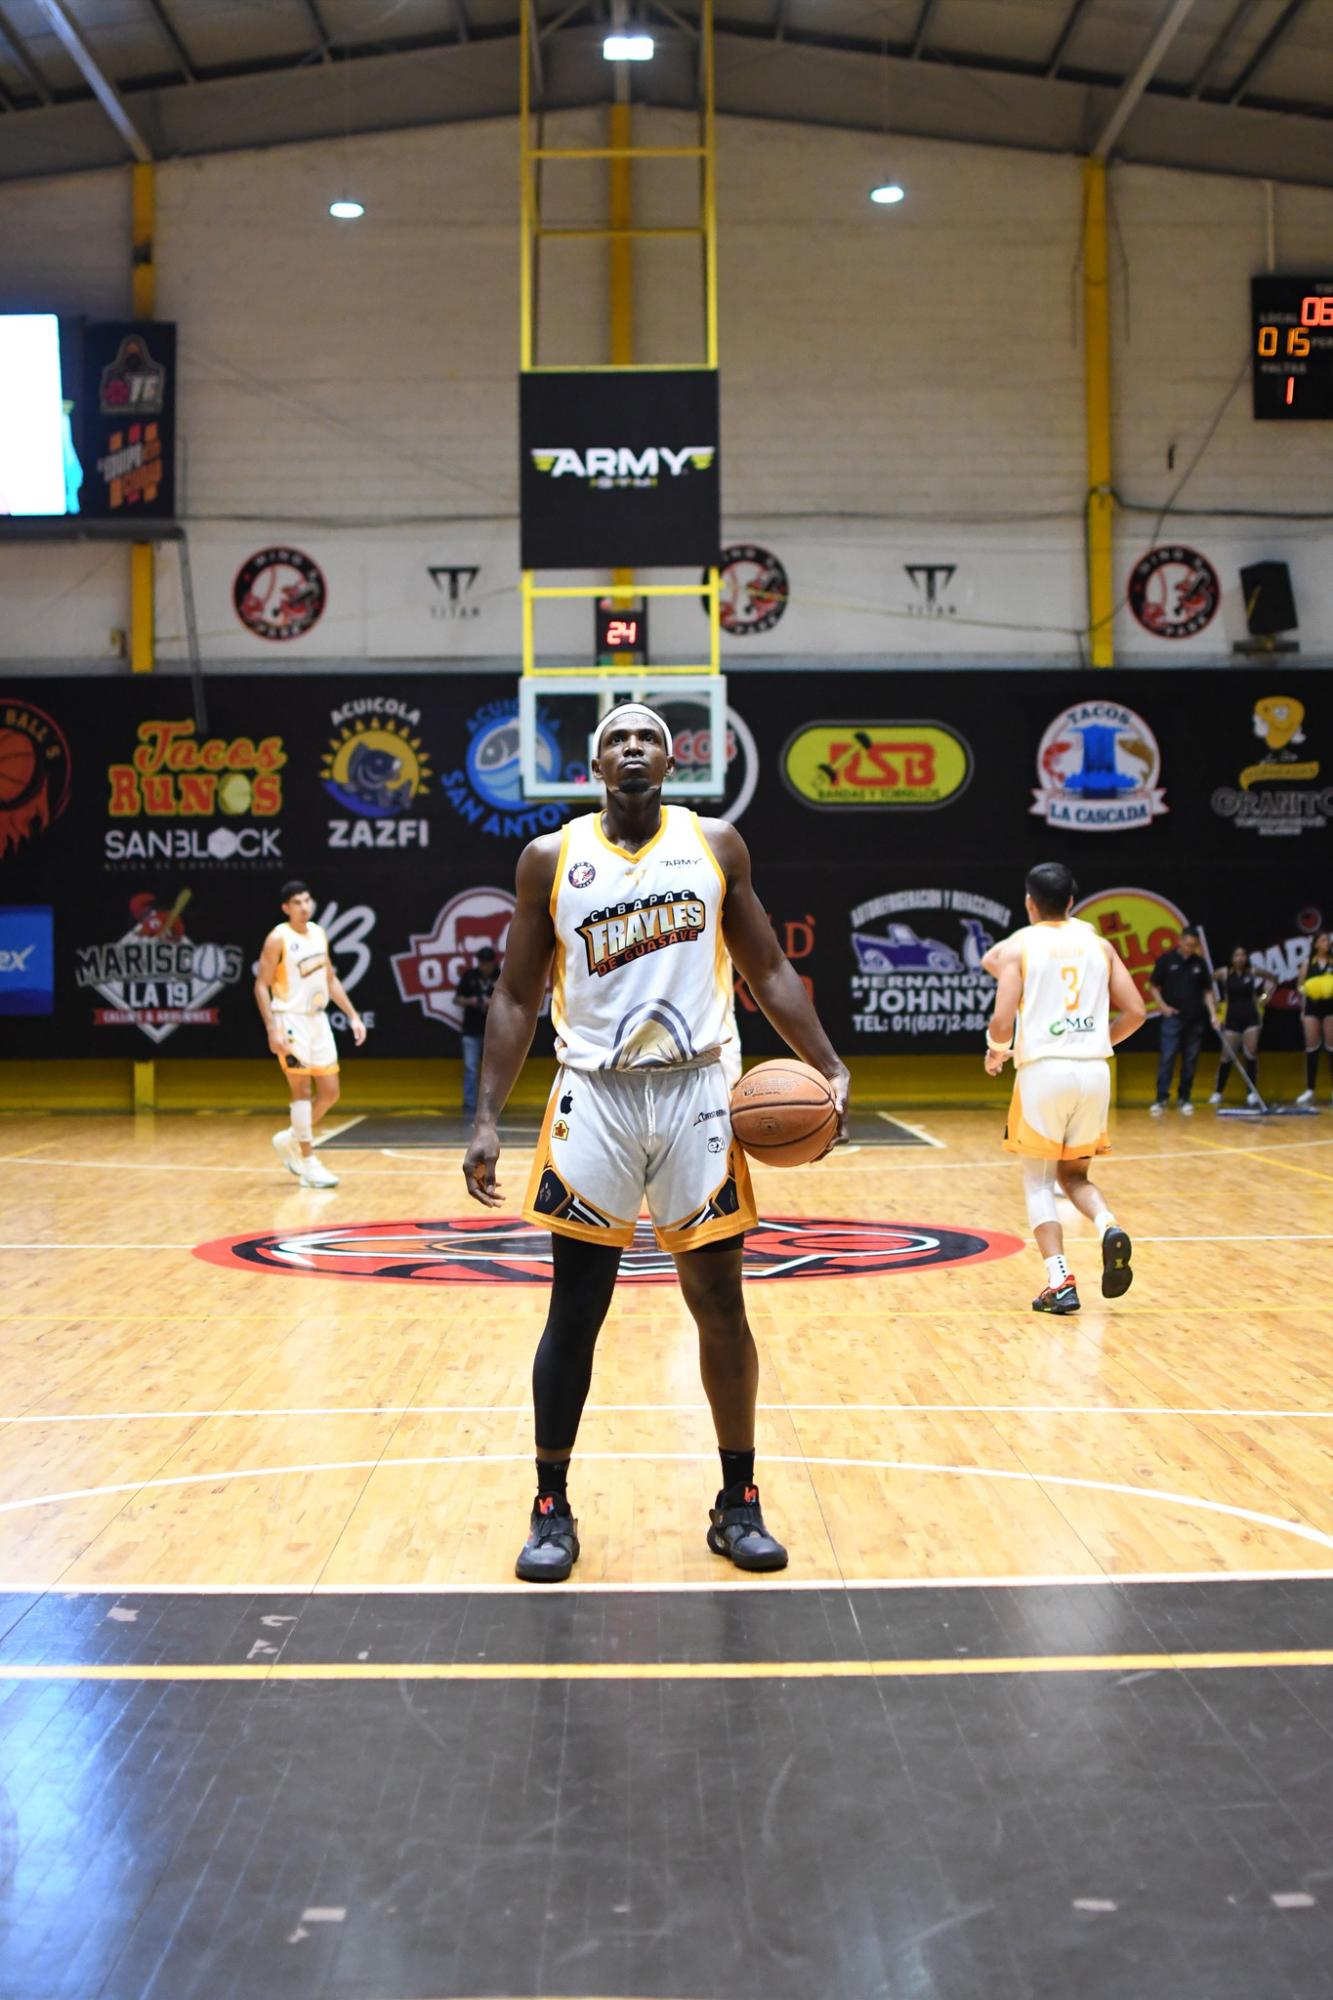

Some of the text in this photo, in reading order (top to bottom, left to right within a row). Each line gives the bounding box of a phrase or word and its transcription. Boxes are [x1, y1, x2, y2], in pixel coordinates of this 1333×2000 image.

[531, 446, 714, 478] ARMY
[607, 621, 636, 645] 24
[1066, 706, 1130, 728] TACOS
[135, 719, 287, 772] Tacos
[441, 769, 485, 824] SAN
[1050, 803, 1148, 824] LA CASCADA
[328, 820, 429, 847] ZAZFI
[590, 889, 690, 922] CIBAPAC
[588, 903, 702, 964] FRAYLES
[1098, 911, 1131, 941] EL
[76, 942, 243, 988] MARISCOS
[597, 929, 698, 976] DE GUASAVE
[129, 982, 189, 1007] LA 19
[852, 975, 997, 989] HERNANDE
[1060, 966, 1080, 1011] 3
[852, 1014, 888, 1032] TEL:
